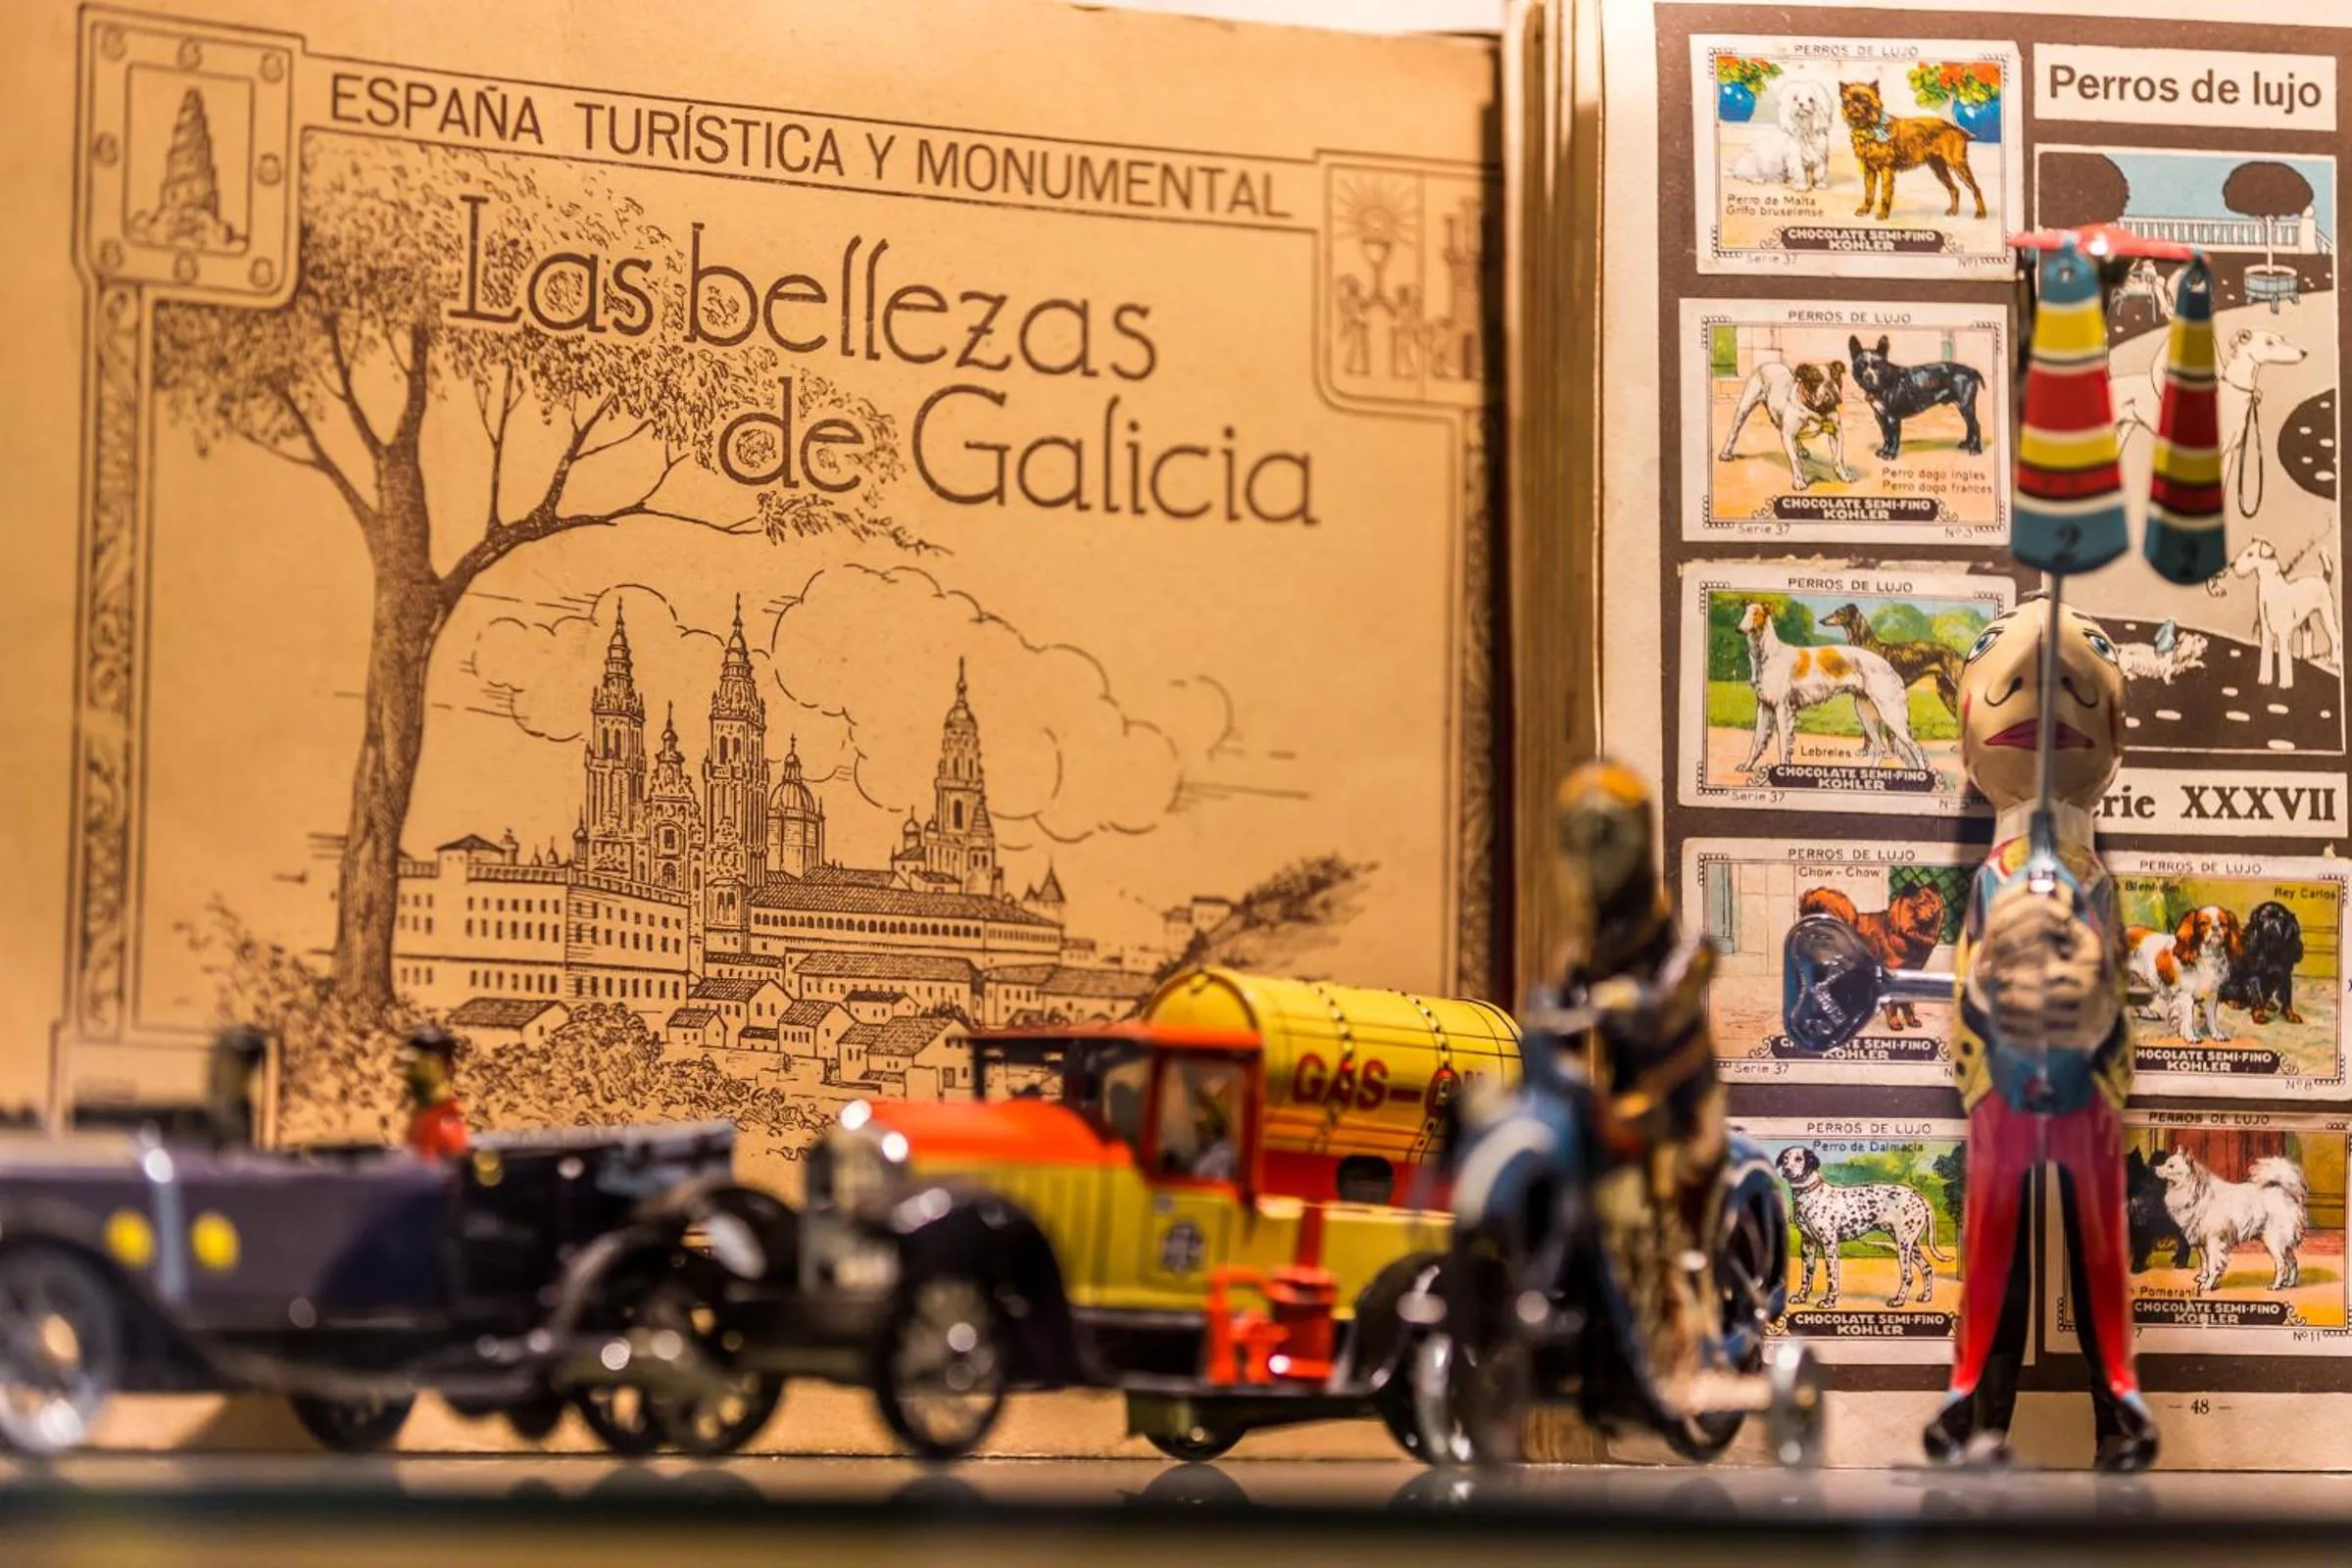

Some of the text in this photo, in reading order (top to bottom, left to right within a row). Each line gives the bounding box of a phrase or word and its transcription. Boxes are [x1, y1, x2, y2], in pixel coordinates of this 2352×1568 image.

[1794, 45, 1919, 58] PERROS DE LUJO
[2048, 64, 2323, 115] Perros de lujo
[331, 72, 1293, 218] ESPAÑA TURÍSTICA Y MONUMENTAL
[1726, 194, 1817, 207] Perro de Malta
[1788, 228, 1936, 243] CHOCOLATE SEMI-FINO
[1828, 239, 1895, 251] KOHLER
[1744, 252, 1798, 266] Serie 37
[447, 195, 1158, 380] Las bellezas
[1788, 310, 1912, 324] PERROS DE LUJO
[717, 375, 1320, 525] de Galicia
[1882, 466, 1914, 479] Perro
[1882, 479, 1916, 491] Perro
[1782, 497, 1932, 512] CHOCOLATE SEMI-FINO
[1822, 509, 1890, 521] KOHLER
[1737, 522, 1791, 536] Serie 37
[1788, 577, 1914, 593] PERROS DE LUJO
[1800, 745, 1852, 759] Lebreles
[1776, 765, 1929, 782] CHOCOLATE SEMI-FINO
[1818, 778, 1886, 791] KOHLER
[1732, 790, 1786, 803] Serie 37
[2180, 785, 2337, 822] XXXVII
[1788, 848, 1916, 861] PERROS DE LUJO
[2139, 859, 2263, 875] PERROS DE LUJO
[1865, 1038, 1932, 1052] SEMI-FINO
[2135, 1049, 2273, 1064] HOCOLATE SEMI-FINO
[1734, 1061, 1790, 1075] Serie 37
[2166, 1060, 2232, 1073] KOHLER
[2148, 1111, 2271, 1126] PERROS DE LUJO
[1807, 1121, 1933, 1136] PERROS DE LUJO
[1813, 1140, 1925, 1153] Perro de Dalmacia
[2134, 1301, 2280, 1315] CHOCOLATE SEMI-FINO
[1794, 1312, 1945, 1326] CHOCOLATE SEMI-FINO
[1836, 1324, 1904, 1337] KOHLER
